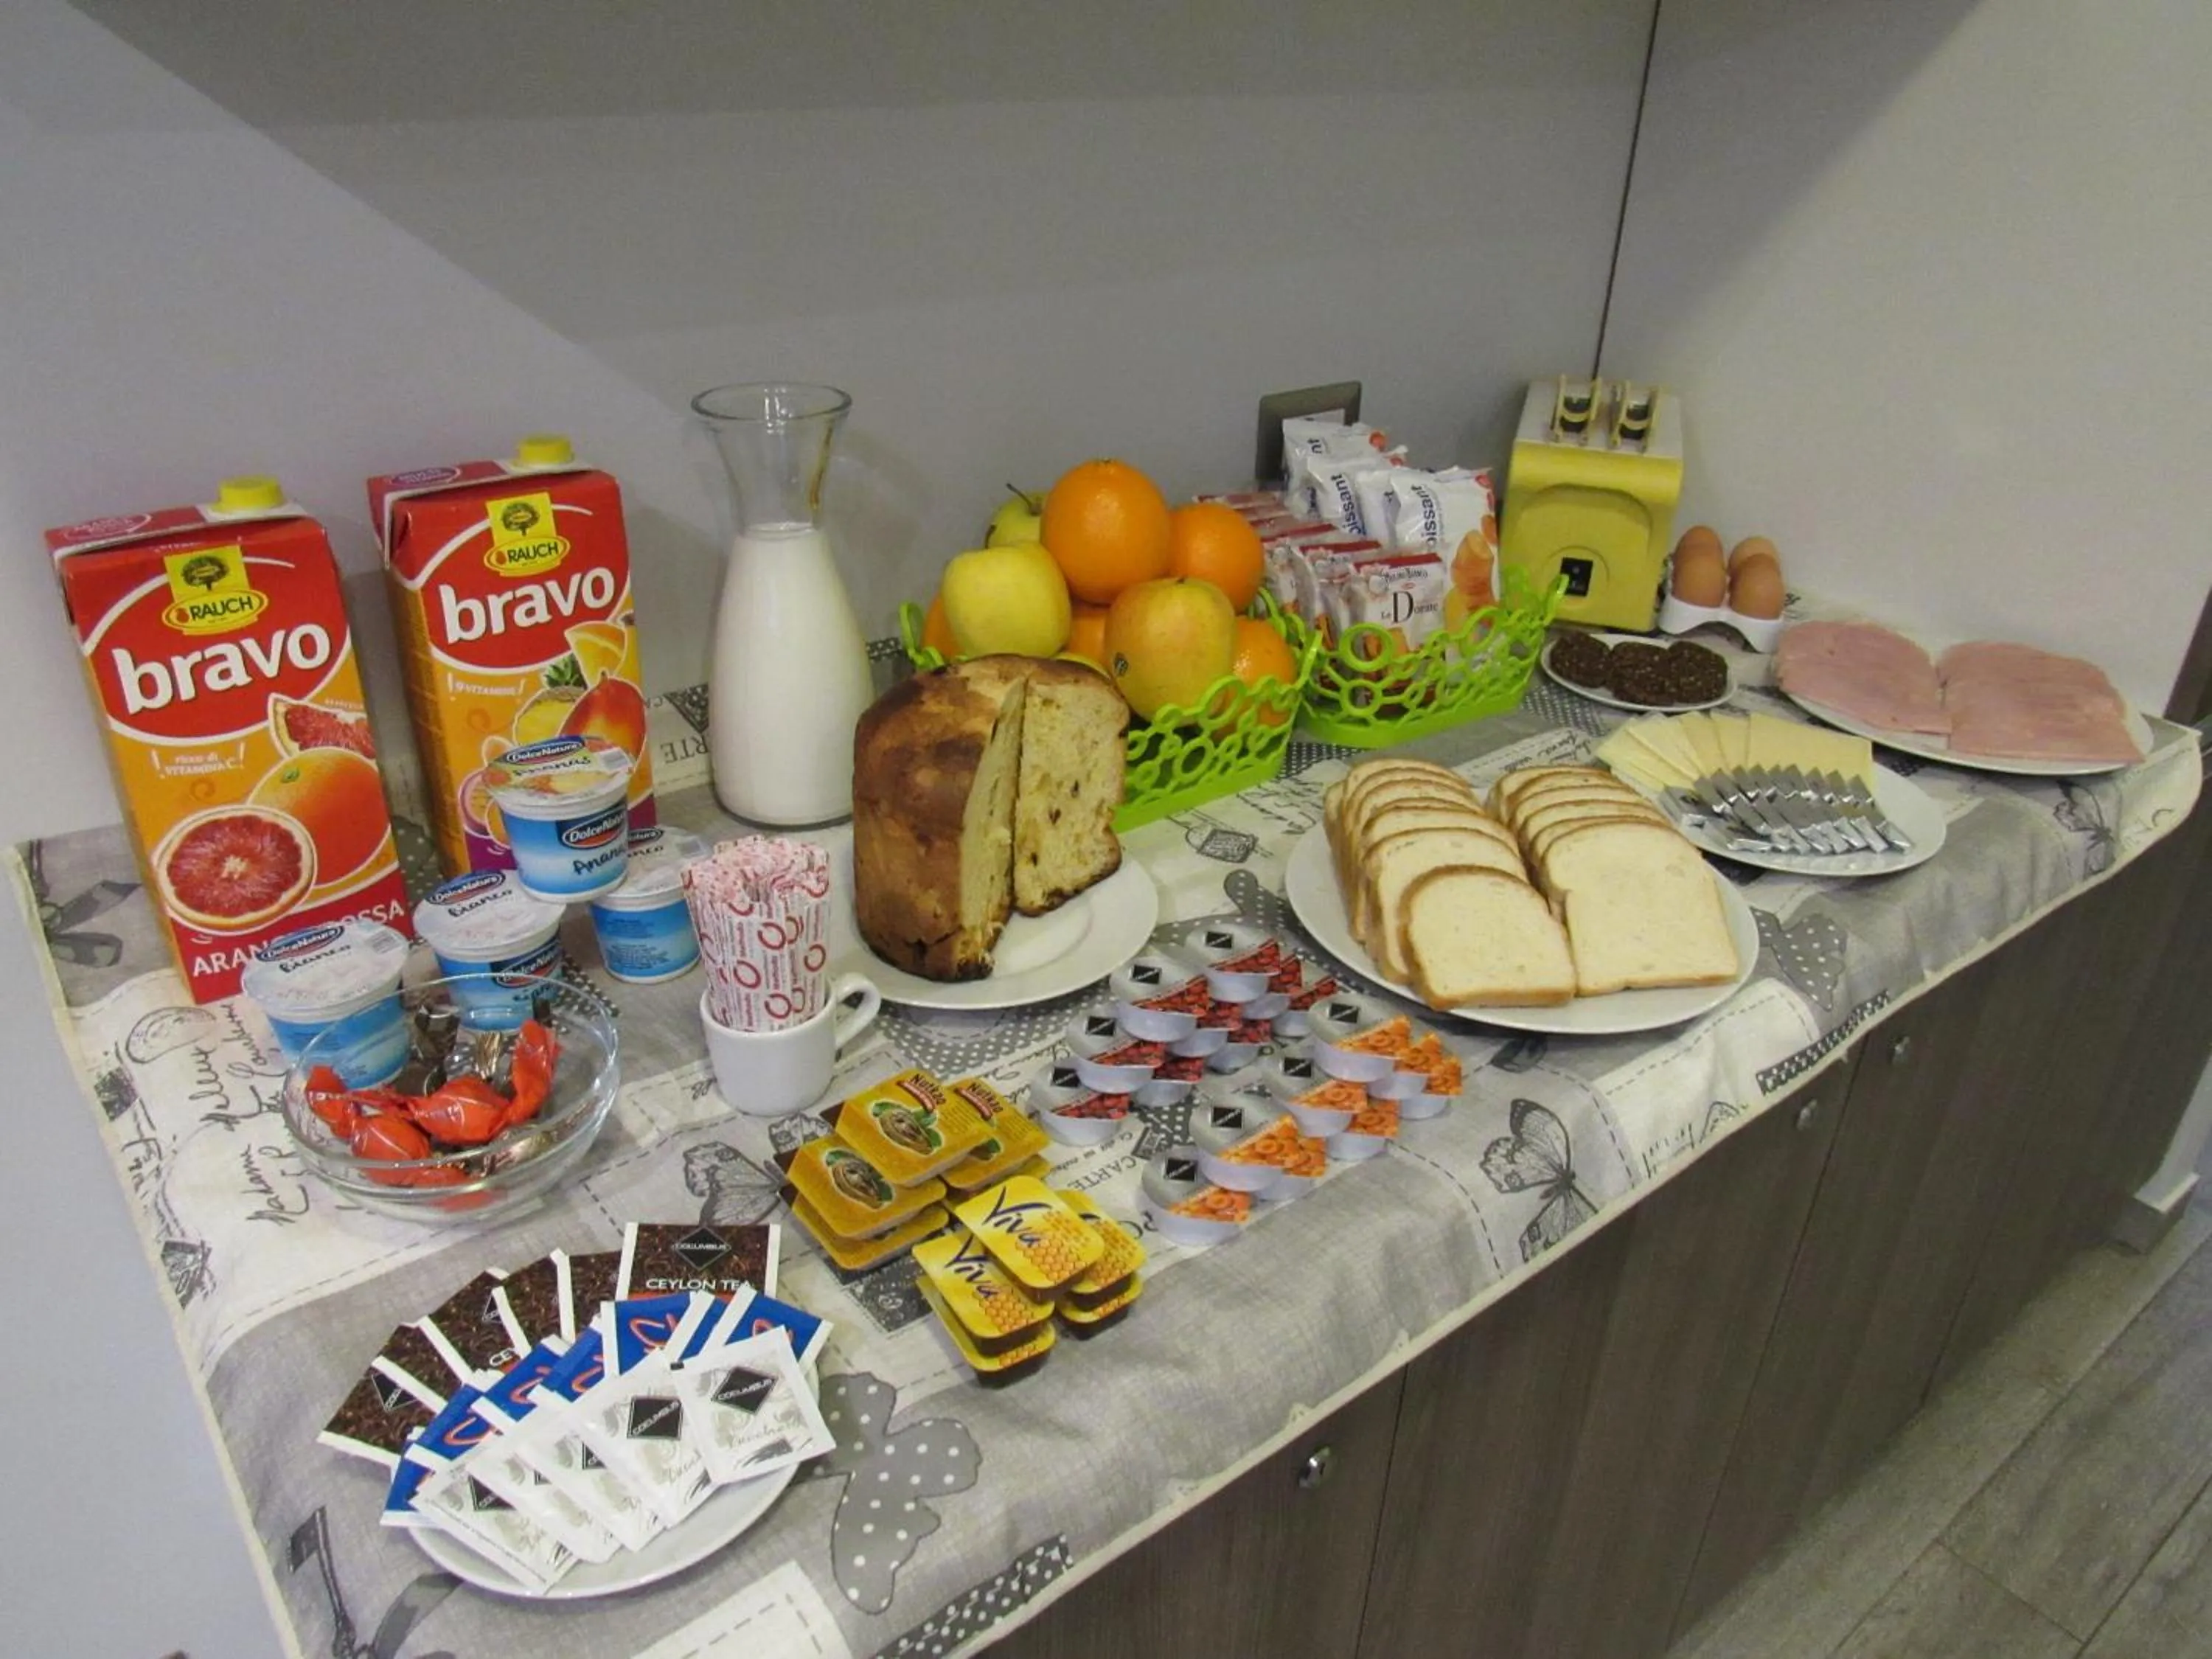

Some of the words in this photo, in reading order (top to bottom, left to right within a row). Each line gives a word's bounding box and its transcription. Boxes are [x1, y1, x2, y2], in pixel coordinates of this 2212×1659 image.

[1331, 473, 1364, 535] oissant
[1411, 484, 1438, 546] oissant
[507, 542, 560, 564] RAUCH
[189, 595, 254, 621] RAUCH
[439, 567, 616, 644] bravo
[111, 624, 331, 714] bravo
[660, 734, 709, 765] RTE
[573, 847, 627, 875] Anan
[193, 936, 280, 977] ARAN
[1067, 1155, 1137, 1192] CARTE
[981, 1186, 1052, 1248] Viva
[646, 1278, 717, 1290] CEYLON
[944, 1233, 999, 1298] Viva
